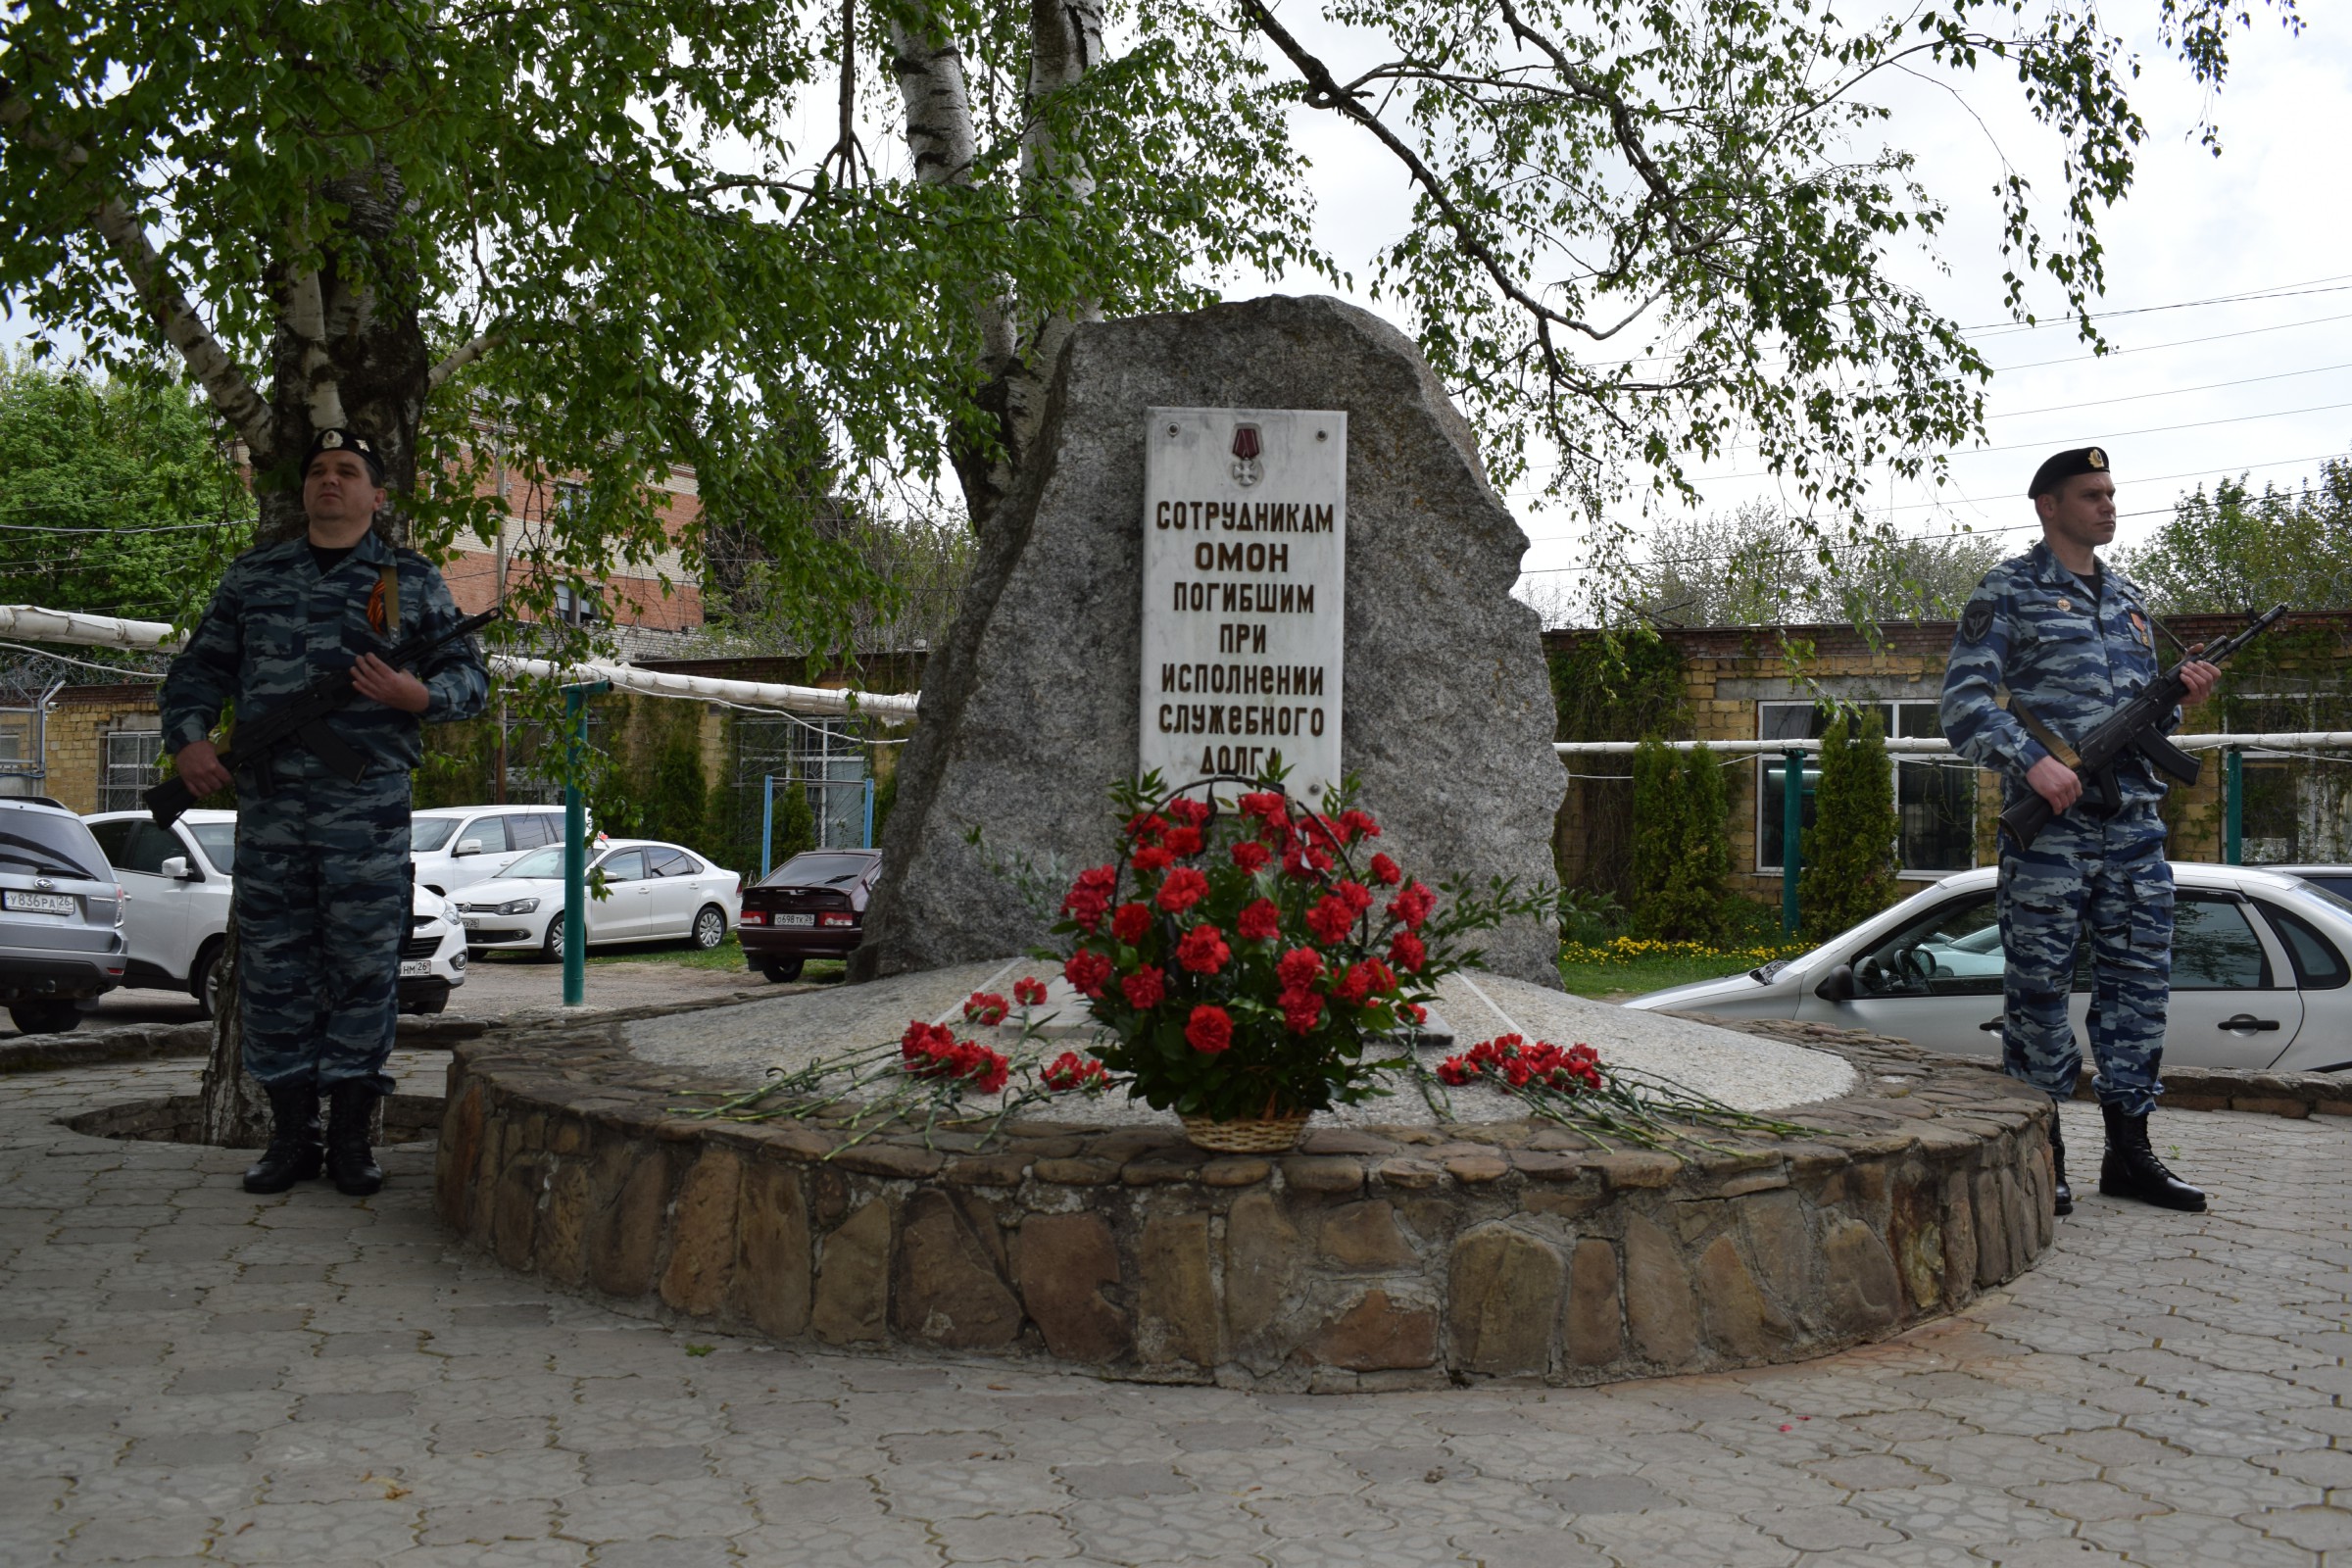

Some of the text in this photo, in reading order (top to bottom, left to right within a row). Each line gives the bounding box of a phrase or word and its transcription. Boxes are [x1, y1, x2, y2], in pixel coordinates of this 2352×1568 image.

[1155, 501, 1334, 533] СОТРУДНИКАМ
[1195, 542, 1289, 572] ОМОН
[1173, 581, 1314, 613] ПОГИБШИМ
[1219, 623, 1266, 654] ПРИ
[1161, 663, 1324, 696] ИСПОЛНЕНИИ
[1158, 704, 1324, 737] СЛУЖЕБНОГО
[58, 896, 71, 906] 26
[417, 961, 427, 971] 26
